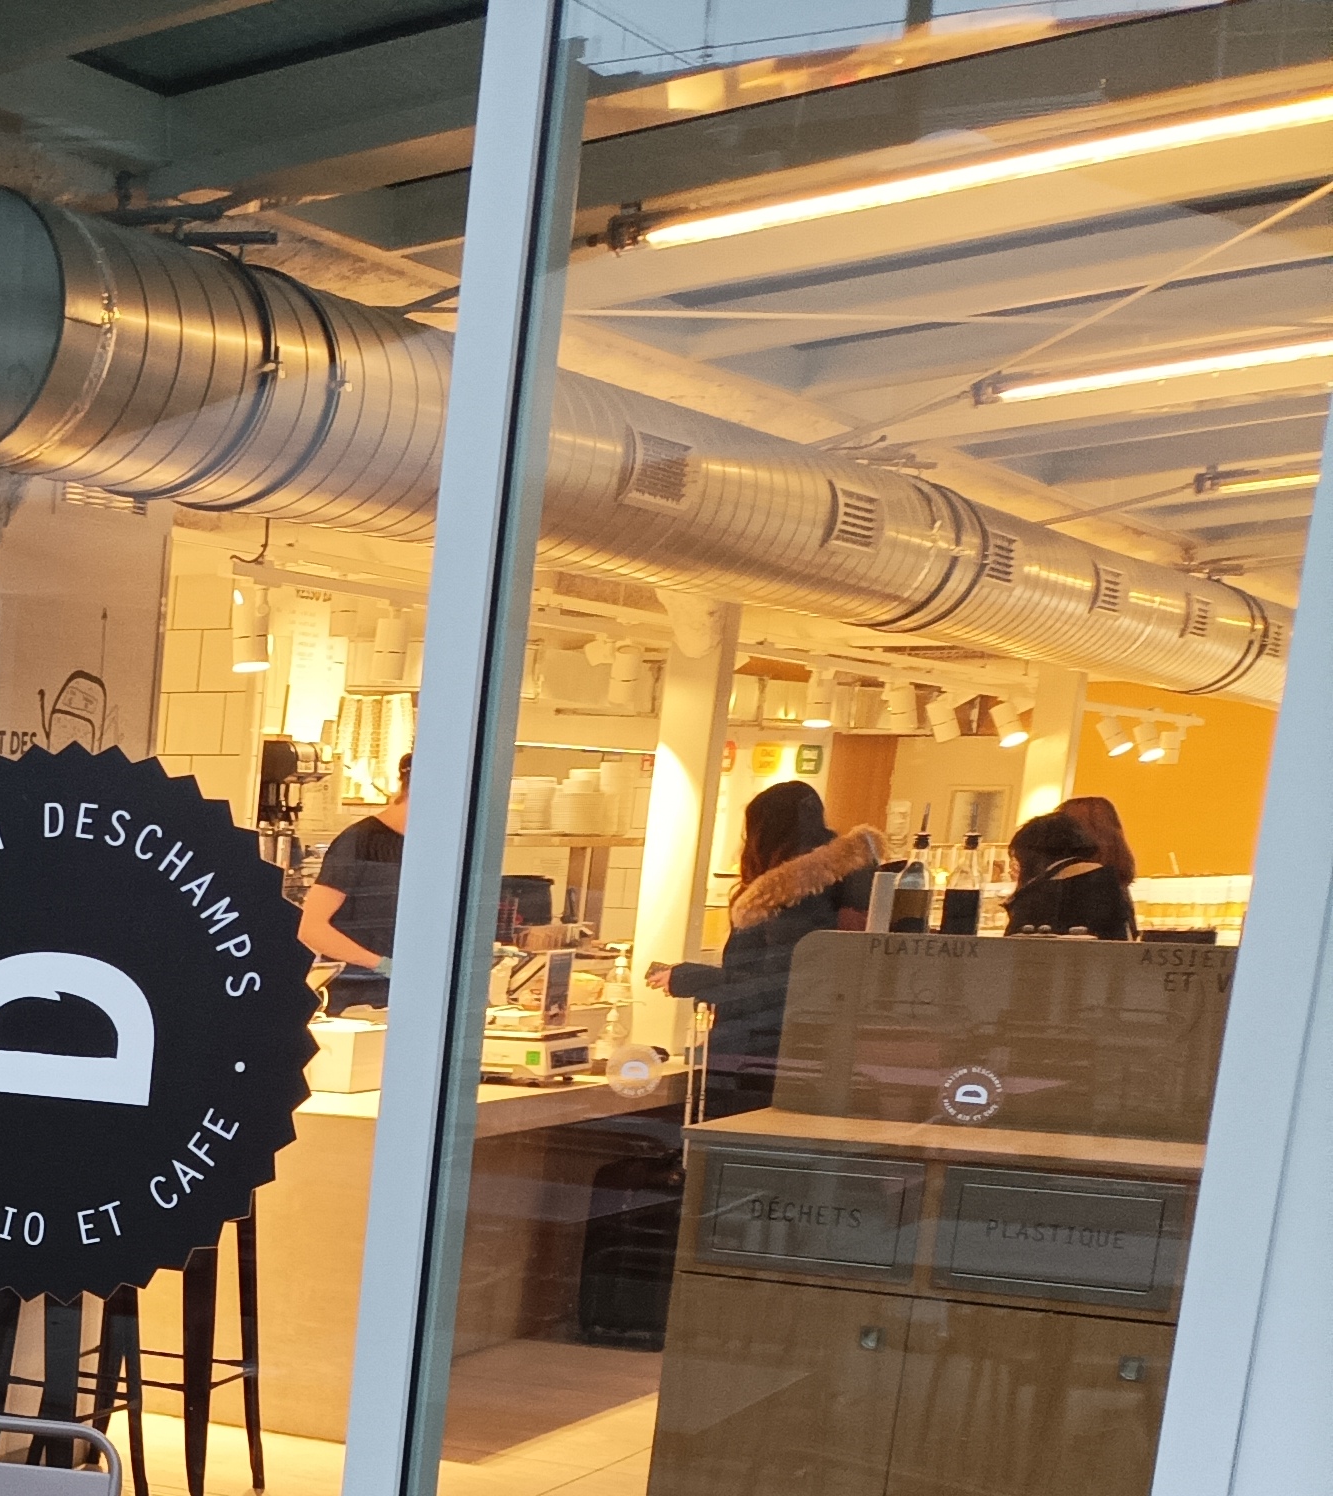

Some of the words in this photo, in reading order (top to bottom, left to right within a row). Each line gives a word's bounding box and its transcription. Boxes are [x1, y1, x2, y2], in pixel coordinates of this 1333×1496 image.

[43, 802, 261, 997] DESCHAMPS
[869, 937, 980, 959] PLATEAUX
[1164, 971, 1196, 992] ET
[77, 1200, 121, 1245] ET
[149, 1107, 240, 1209] CAFE
[751, 1196, 863, 1229] DÉCHETS
[985, 1218, 1127, 1250] PLASTIQUE
